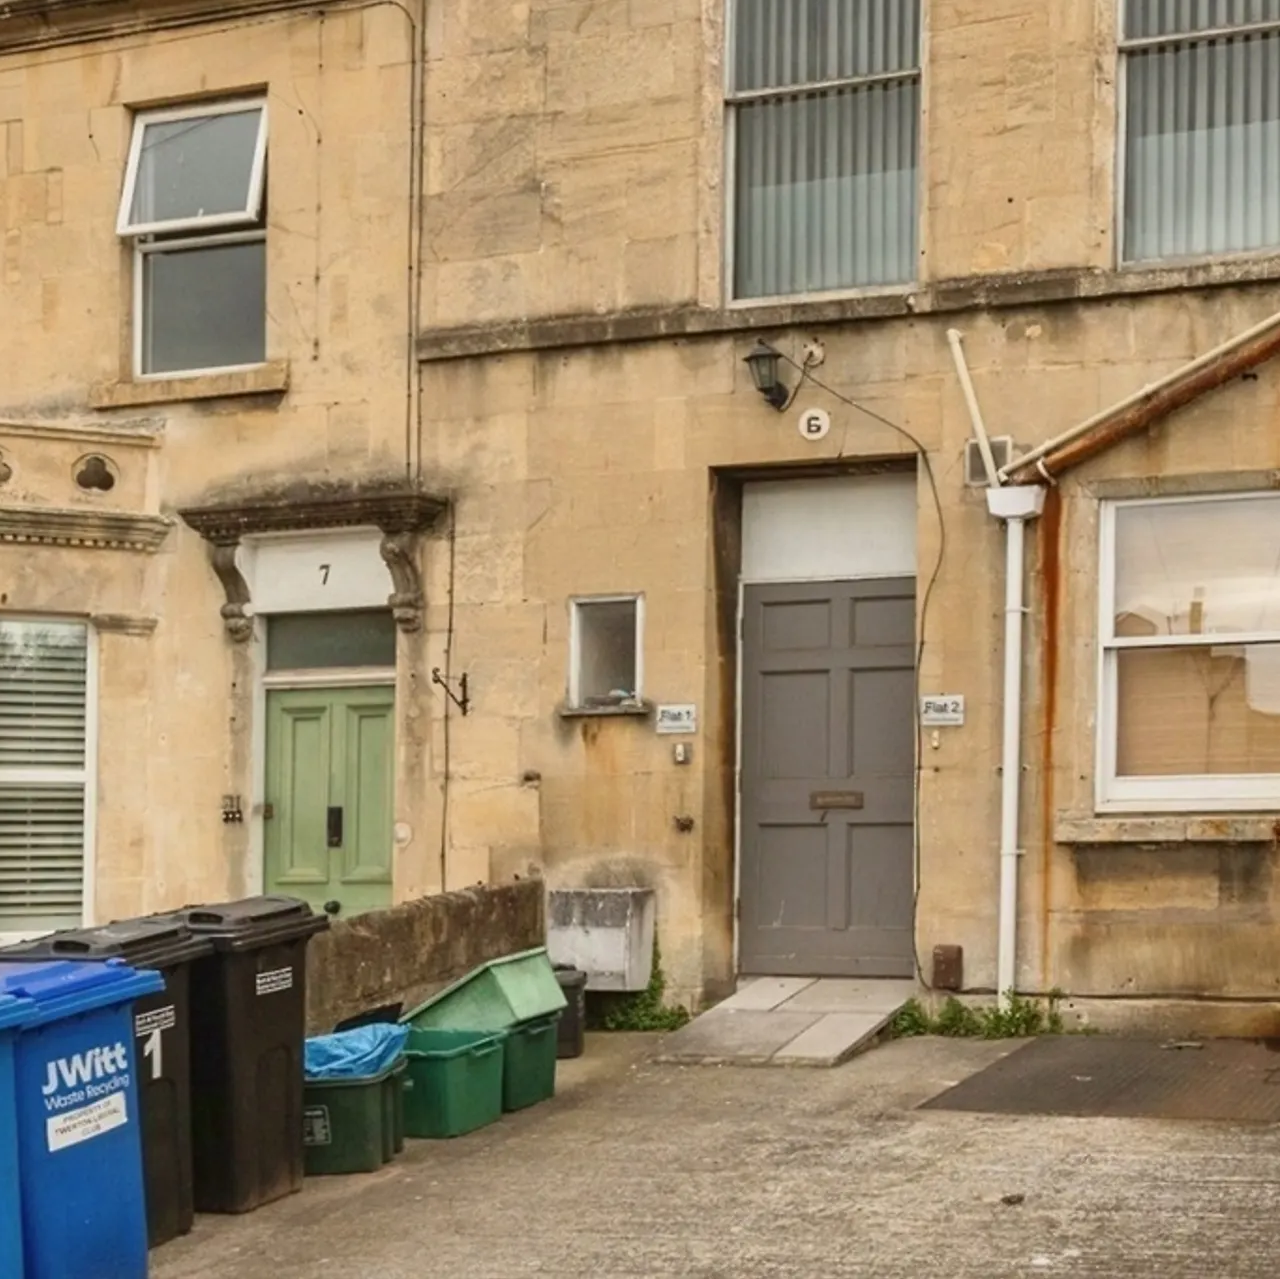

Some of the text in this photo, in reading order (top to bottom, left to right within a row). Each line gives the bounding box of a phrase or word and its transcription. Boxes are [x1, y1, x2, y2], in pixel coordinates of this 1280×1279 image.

[806, 416, 821, 433] 6
[319, 564, 331, 585] 7
[950, 700, 960, 713] 2
[41, 1041, 128, 1095] JWitt
[144, 1028, 162, 1079] 1
[44, 1074, 130, 1111] Waste Recycling
